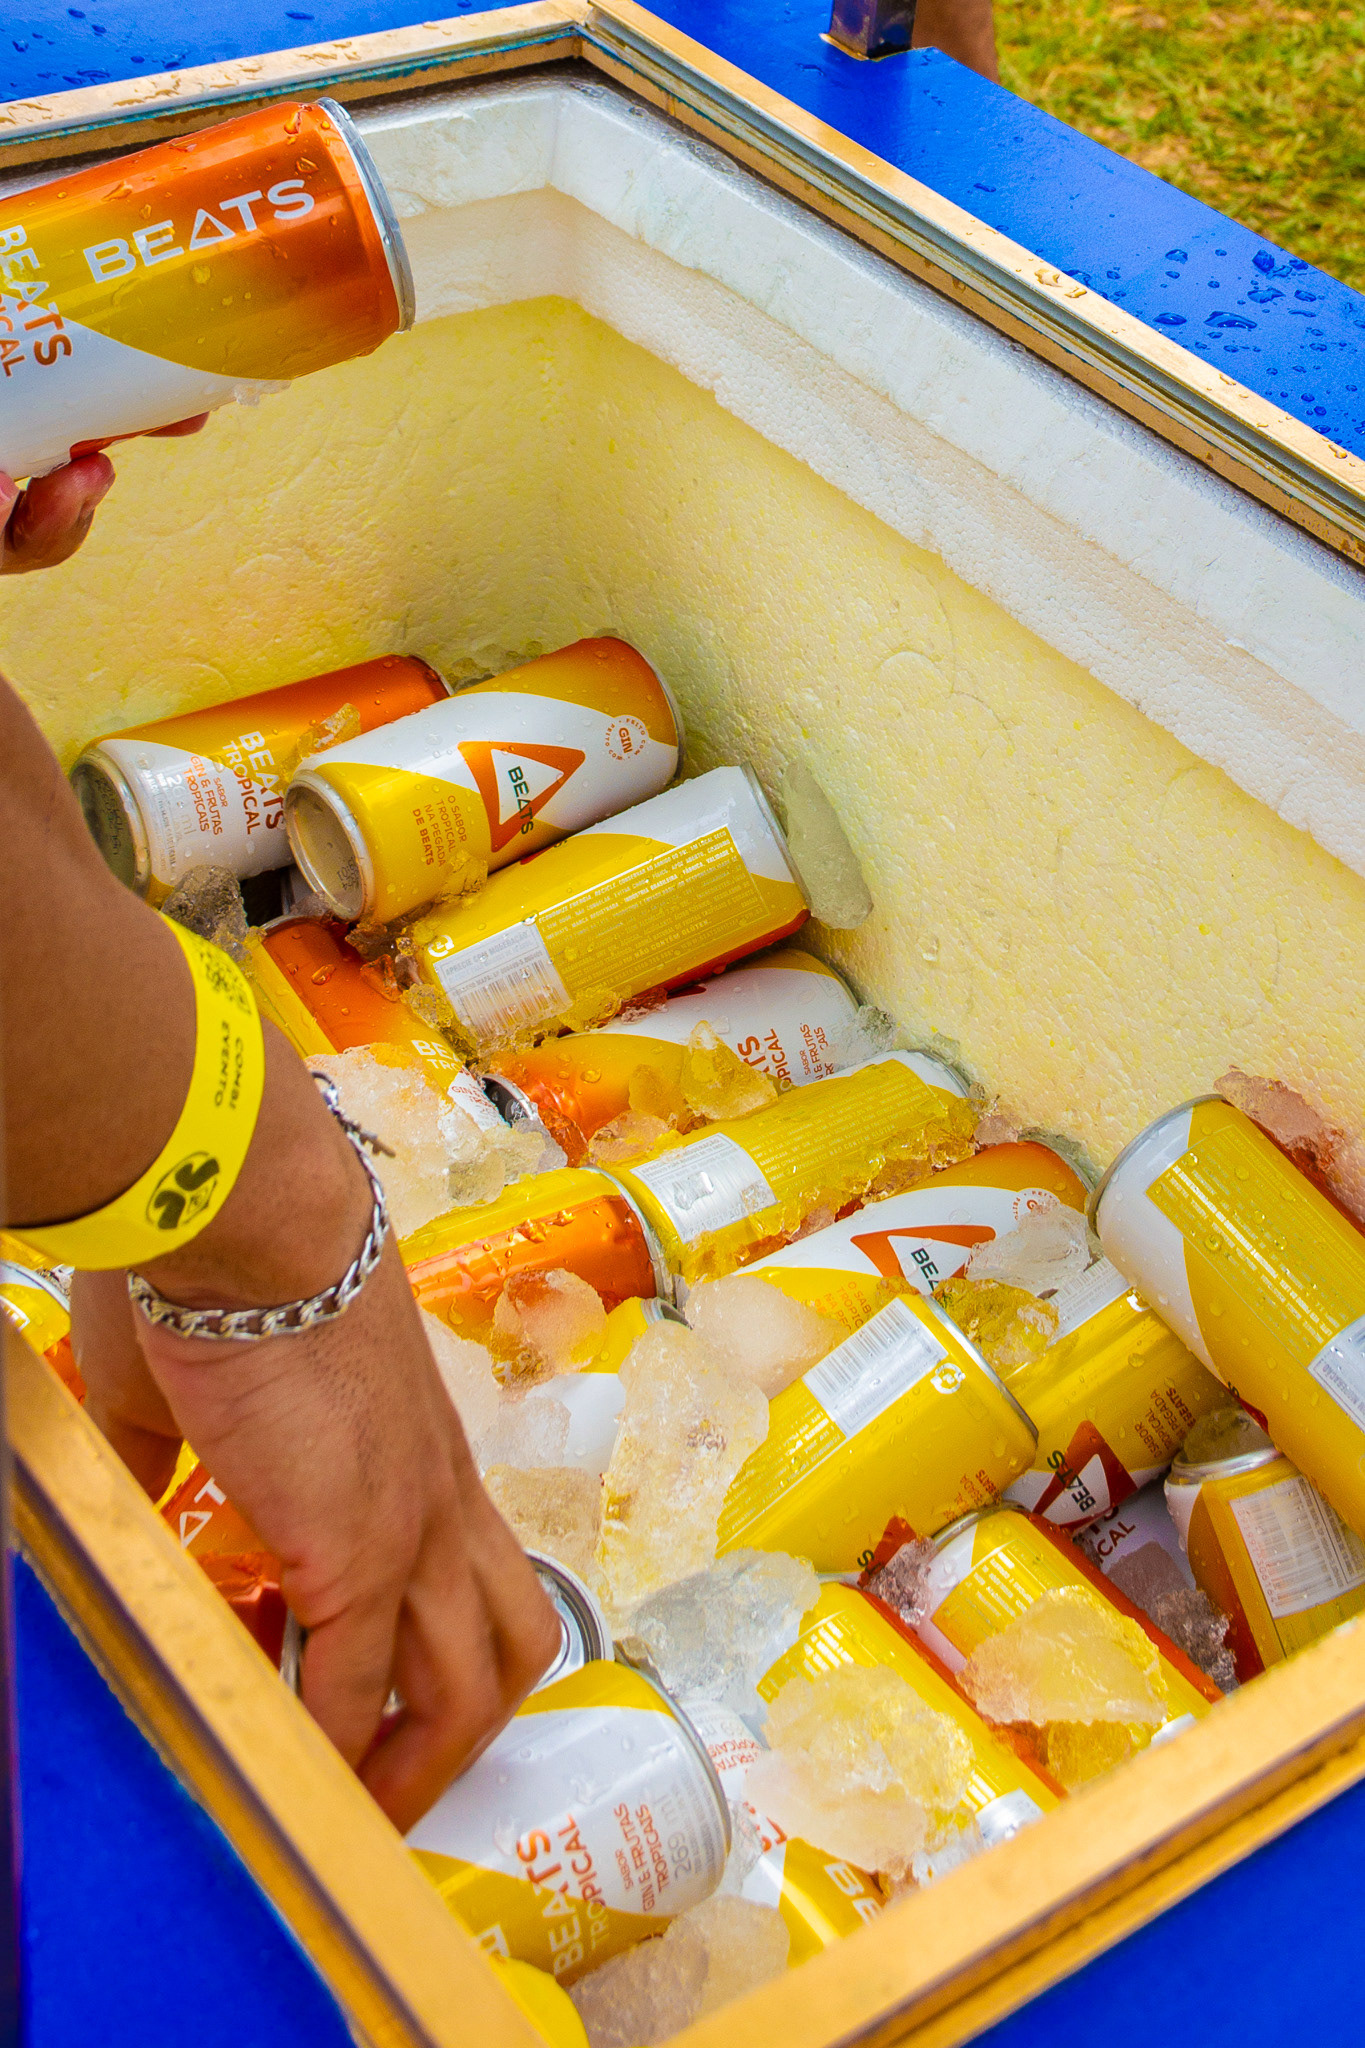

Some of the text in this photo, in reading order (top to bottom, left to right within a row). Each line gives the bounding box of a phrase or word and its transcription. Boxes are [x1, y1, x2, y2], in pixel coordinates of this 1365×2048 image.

[83, 179, 315, 284] BEATS
[618, 727, 633, 755] GIN
[182, 768, 210, 832] TROPICAIS
[190, 755, 208, 780] GIN
[205, 791, 223, 836] FRUTAS
[213, 777, 229, 809] SABOR
[221, 740, 261, 836] TROPICAL
[238, 730, 285, 830] BEATS
[507, 765, 534, 835] BEATS
[413, 808, 435, 866] DE BEATS
[424, 804, 447, 868] NA PEGADA
[436, 799, 456, 852] TROPICAL
[447, 795, 468, 843] O SABOR
[214, 1020, 230, 1108] EVENTO
[800, 1023, 820, 1065] FRUTAS
[804, 1048, 814, 1076] SABOR
[852, 1292, 871, 1315] SAB
[1046, 1449, 1096, 1513] BEATS
[613, 1802, 644, 1875] FRUTAS
[615, 1848, 634, 1891] SABOR
[635, 1803, 669, 1893] TROPICAIS
[669, 1830, 692, 1882] 269
[516, 1827, 584, 1977] BEATS
[558, 1813, 608, 1950] TROPICAL
[642, 1887, 656, 1913] GIN
